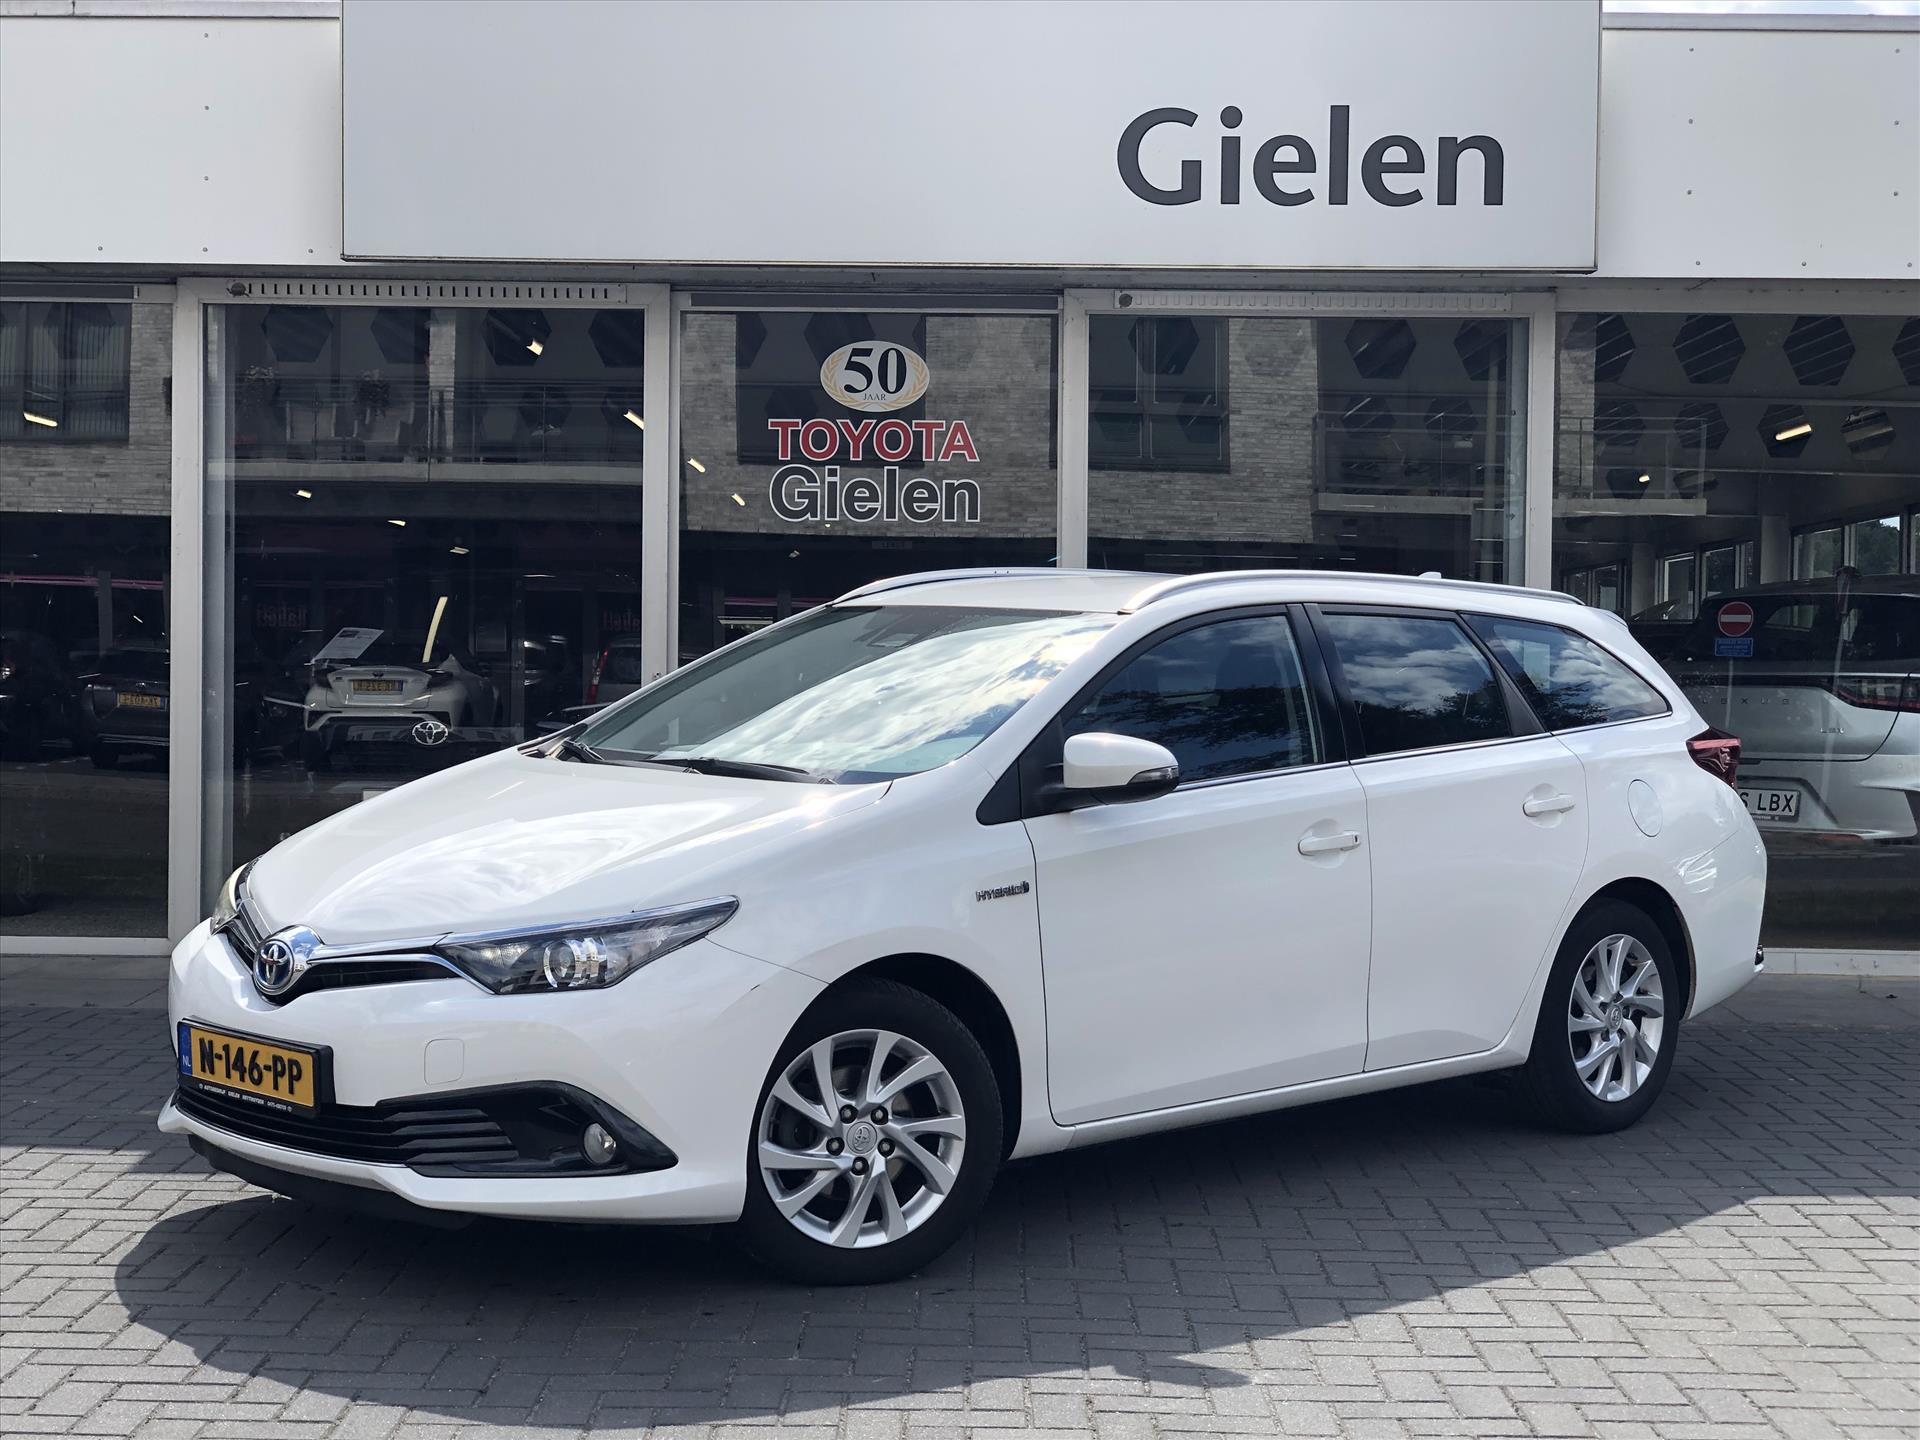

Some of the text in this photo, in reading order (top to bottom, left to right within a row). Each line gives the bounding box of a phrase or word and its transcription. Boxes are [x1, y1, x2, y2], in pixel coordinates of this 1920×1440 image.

[1117, 104, 1504, 207] Gielen
[843, 347, 907, 394] 50
[863, 393, 886, 401] JAAR
[768, 418, 980, 462] TOYOTA
[769, 464, 980, 523] Gielen
[1757, 793, 1794, 812] LBX
[182, 1055, 191, 1067] NL
[199, 1038, 302, 1095] N-146-PP
